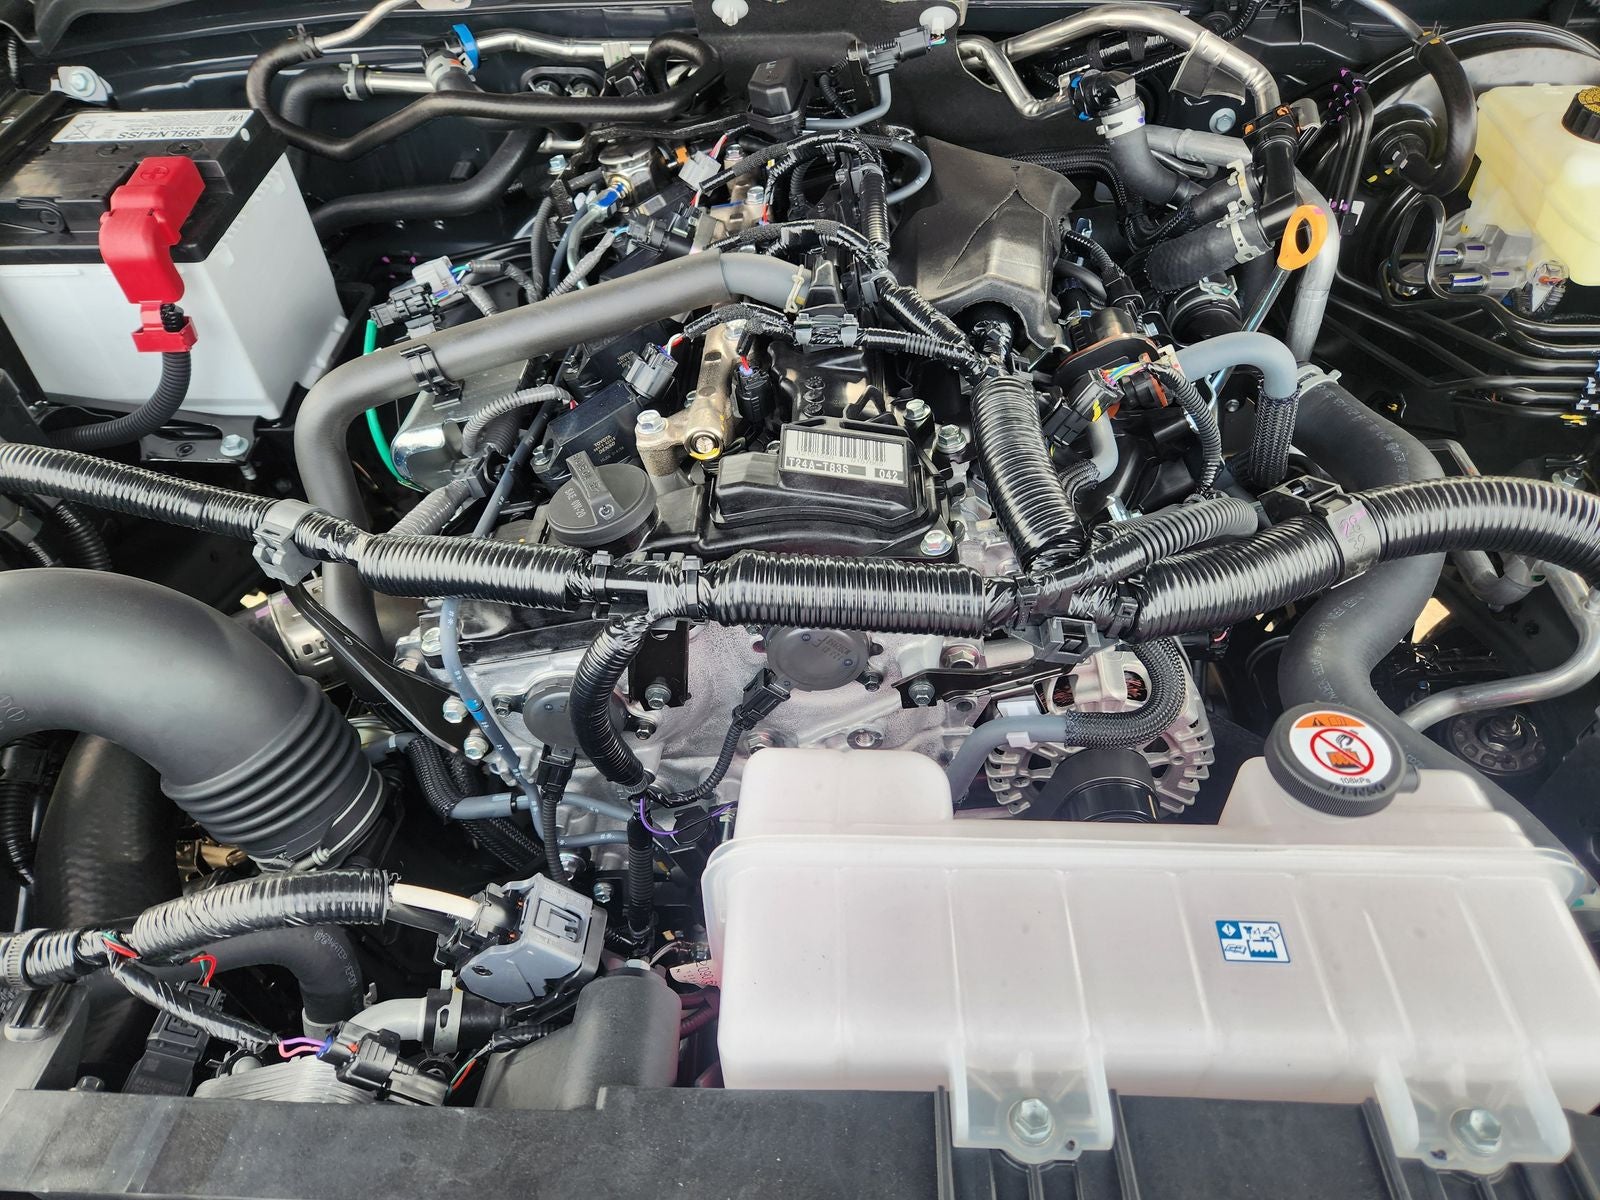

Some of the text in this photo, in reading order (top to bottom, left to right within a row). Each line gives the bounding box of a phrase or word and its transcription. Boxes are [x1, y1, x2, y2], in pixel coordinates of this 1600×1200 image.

[116, 129, 206, 140] 395LN4-ISS
[787, 457, 899, 481] T24A-T83S 042
